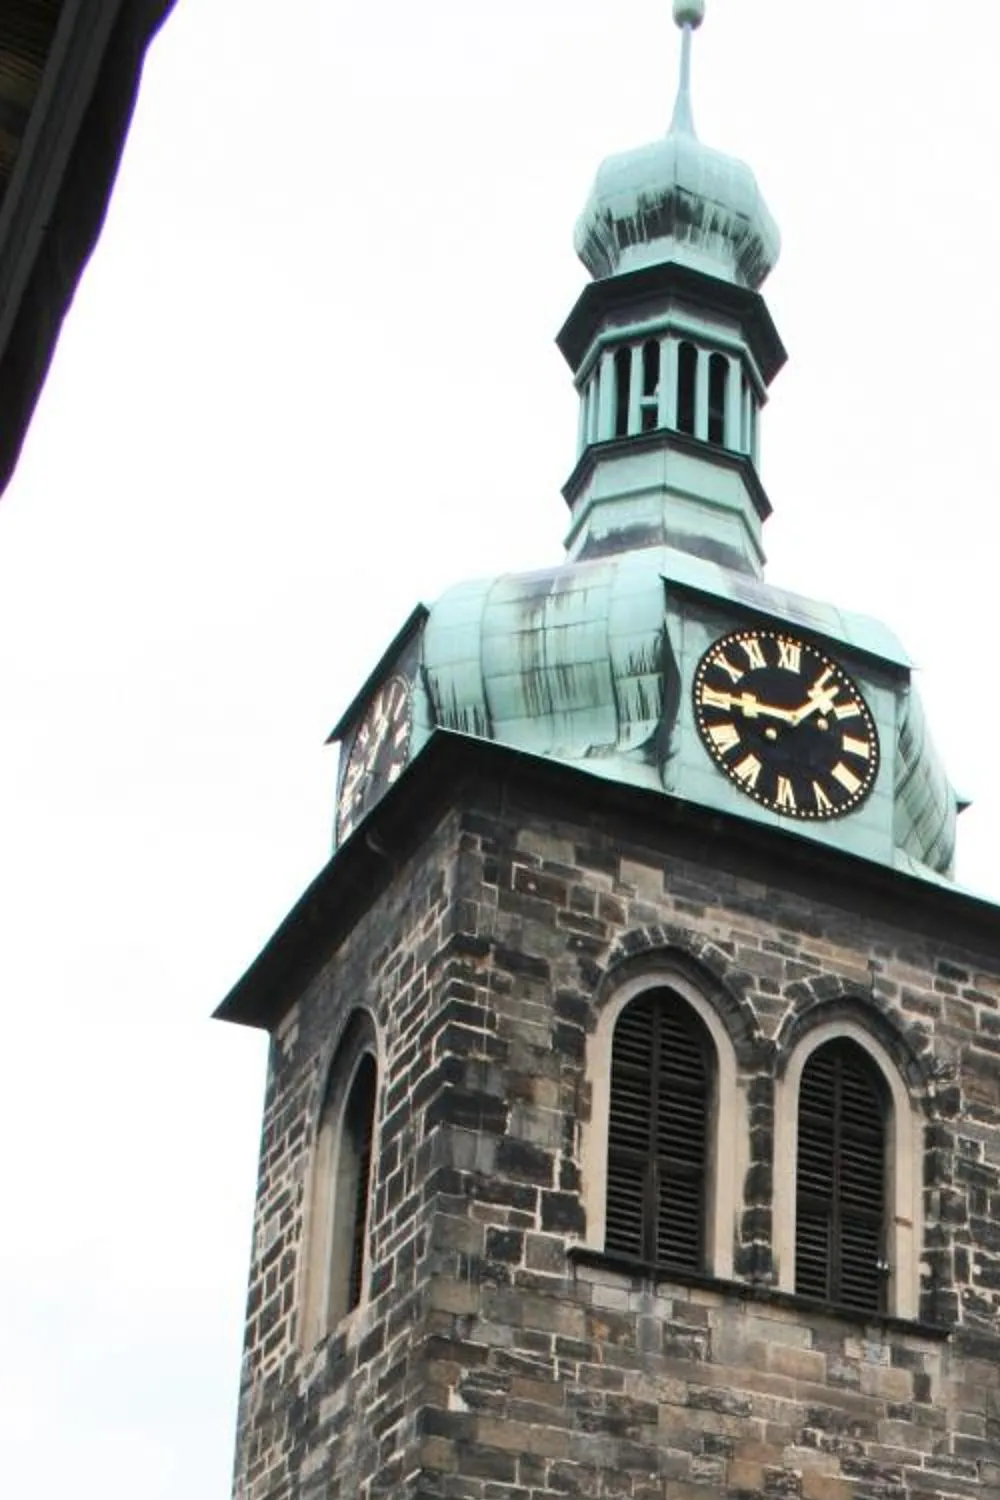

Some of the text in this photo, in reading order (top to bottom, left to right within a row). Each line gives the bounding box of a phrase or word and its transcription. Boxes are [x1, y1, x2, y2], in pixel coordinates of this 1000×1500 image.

[713, 653, 745, 684] X
[739, 639, 767, 670] XI
[777, 639, 801, 674] XII
[733, 754, 763, 788] VII
[776, 775, 797, 809] VI
[812, 780, 834, 811] V
